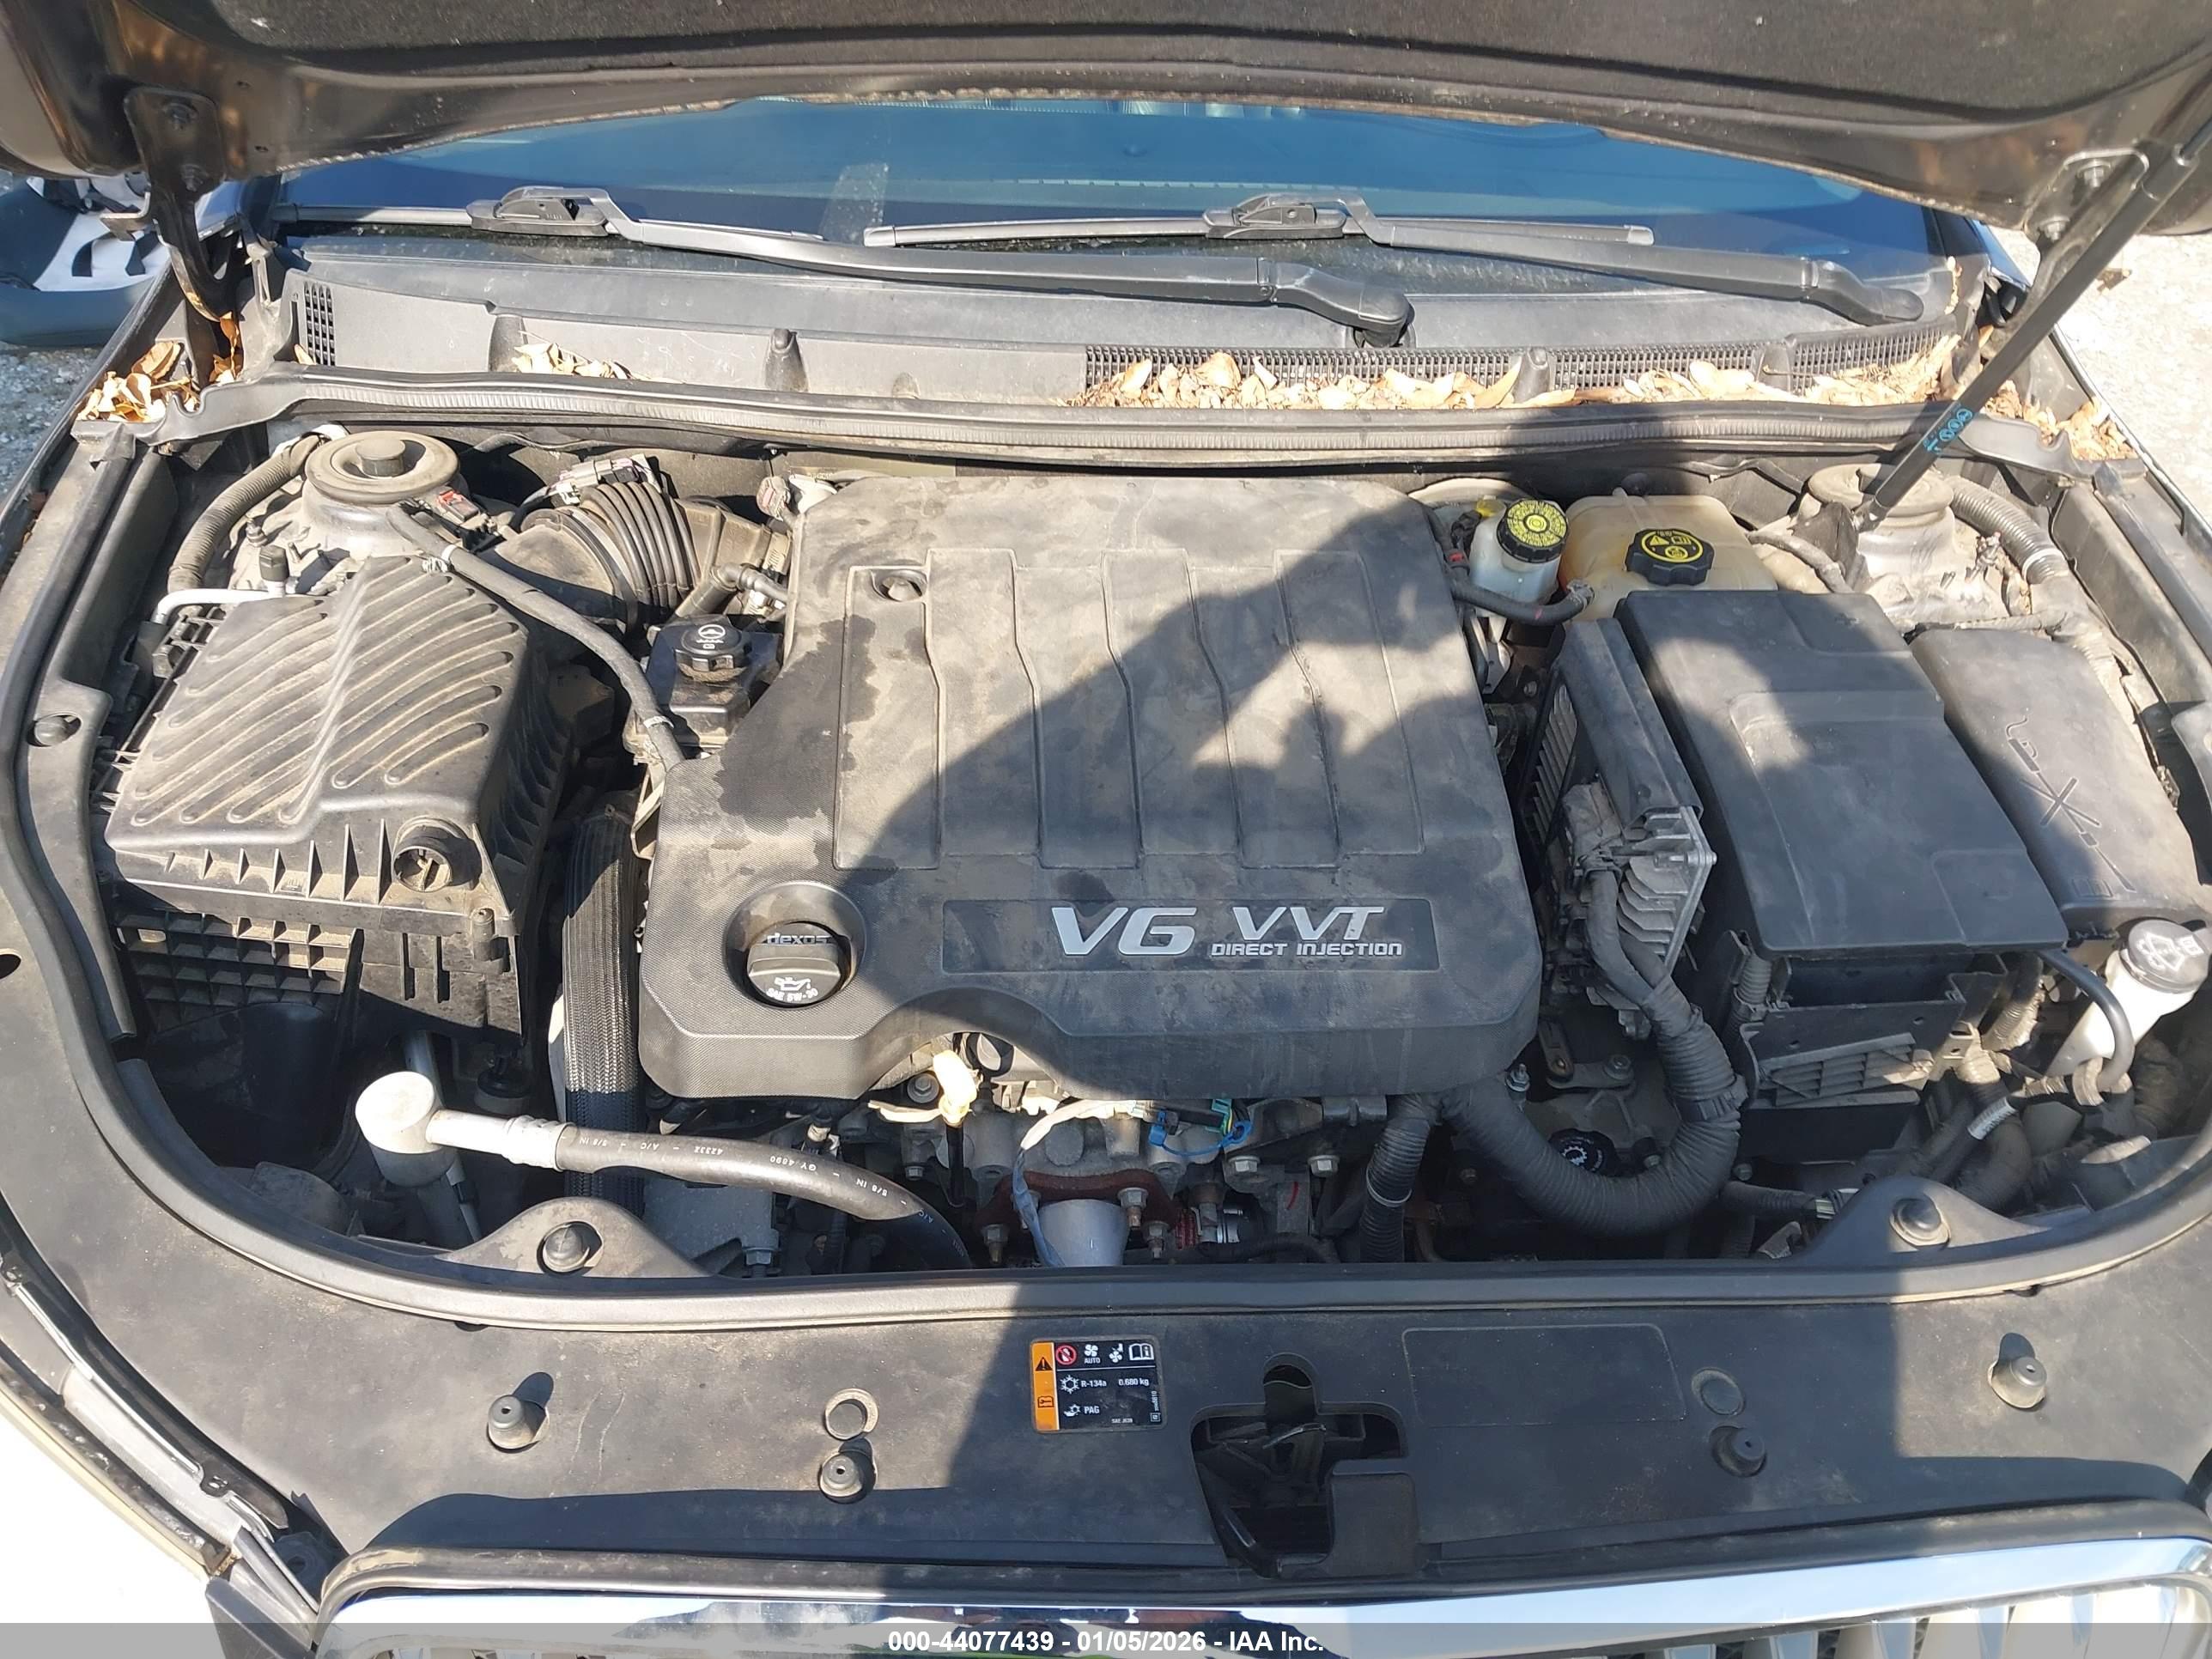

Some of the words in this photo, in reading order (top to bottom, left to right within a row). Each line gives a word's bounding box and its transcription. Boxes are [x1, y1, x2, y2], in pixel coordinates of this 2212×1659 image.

[1051, 907, 1198, 955] V6
[1232, 906, 1384, 940] VVT
[767, 933, 832, 945] dexos
[1211, 943, 1288, 956] DIRECT
[1296, 943, 1402, 956] INJECTION
[766, 988, 785, 1001] SAE
[787, 988, 818, 1002] 5W-30
[579, 1136, 589, 1145] IN
[800, 1162, 817, 1171] GY
[855, 1178, 867, 1188] IN
[872, 1184, 888, 1197] 5/8
[1139, 1377, 1150, 1387] kg
[1084, 1406, 1100, 1414] PAG
